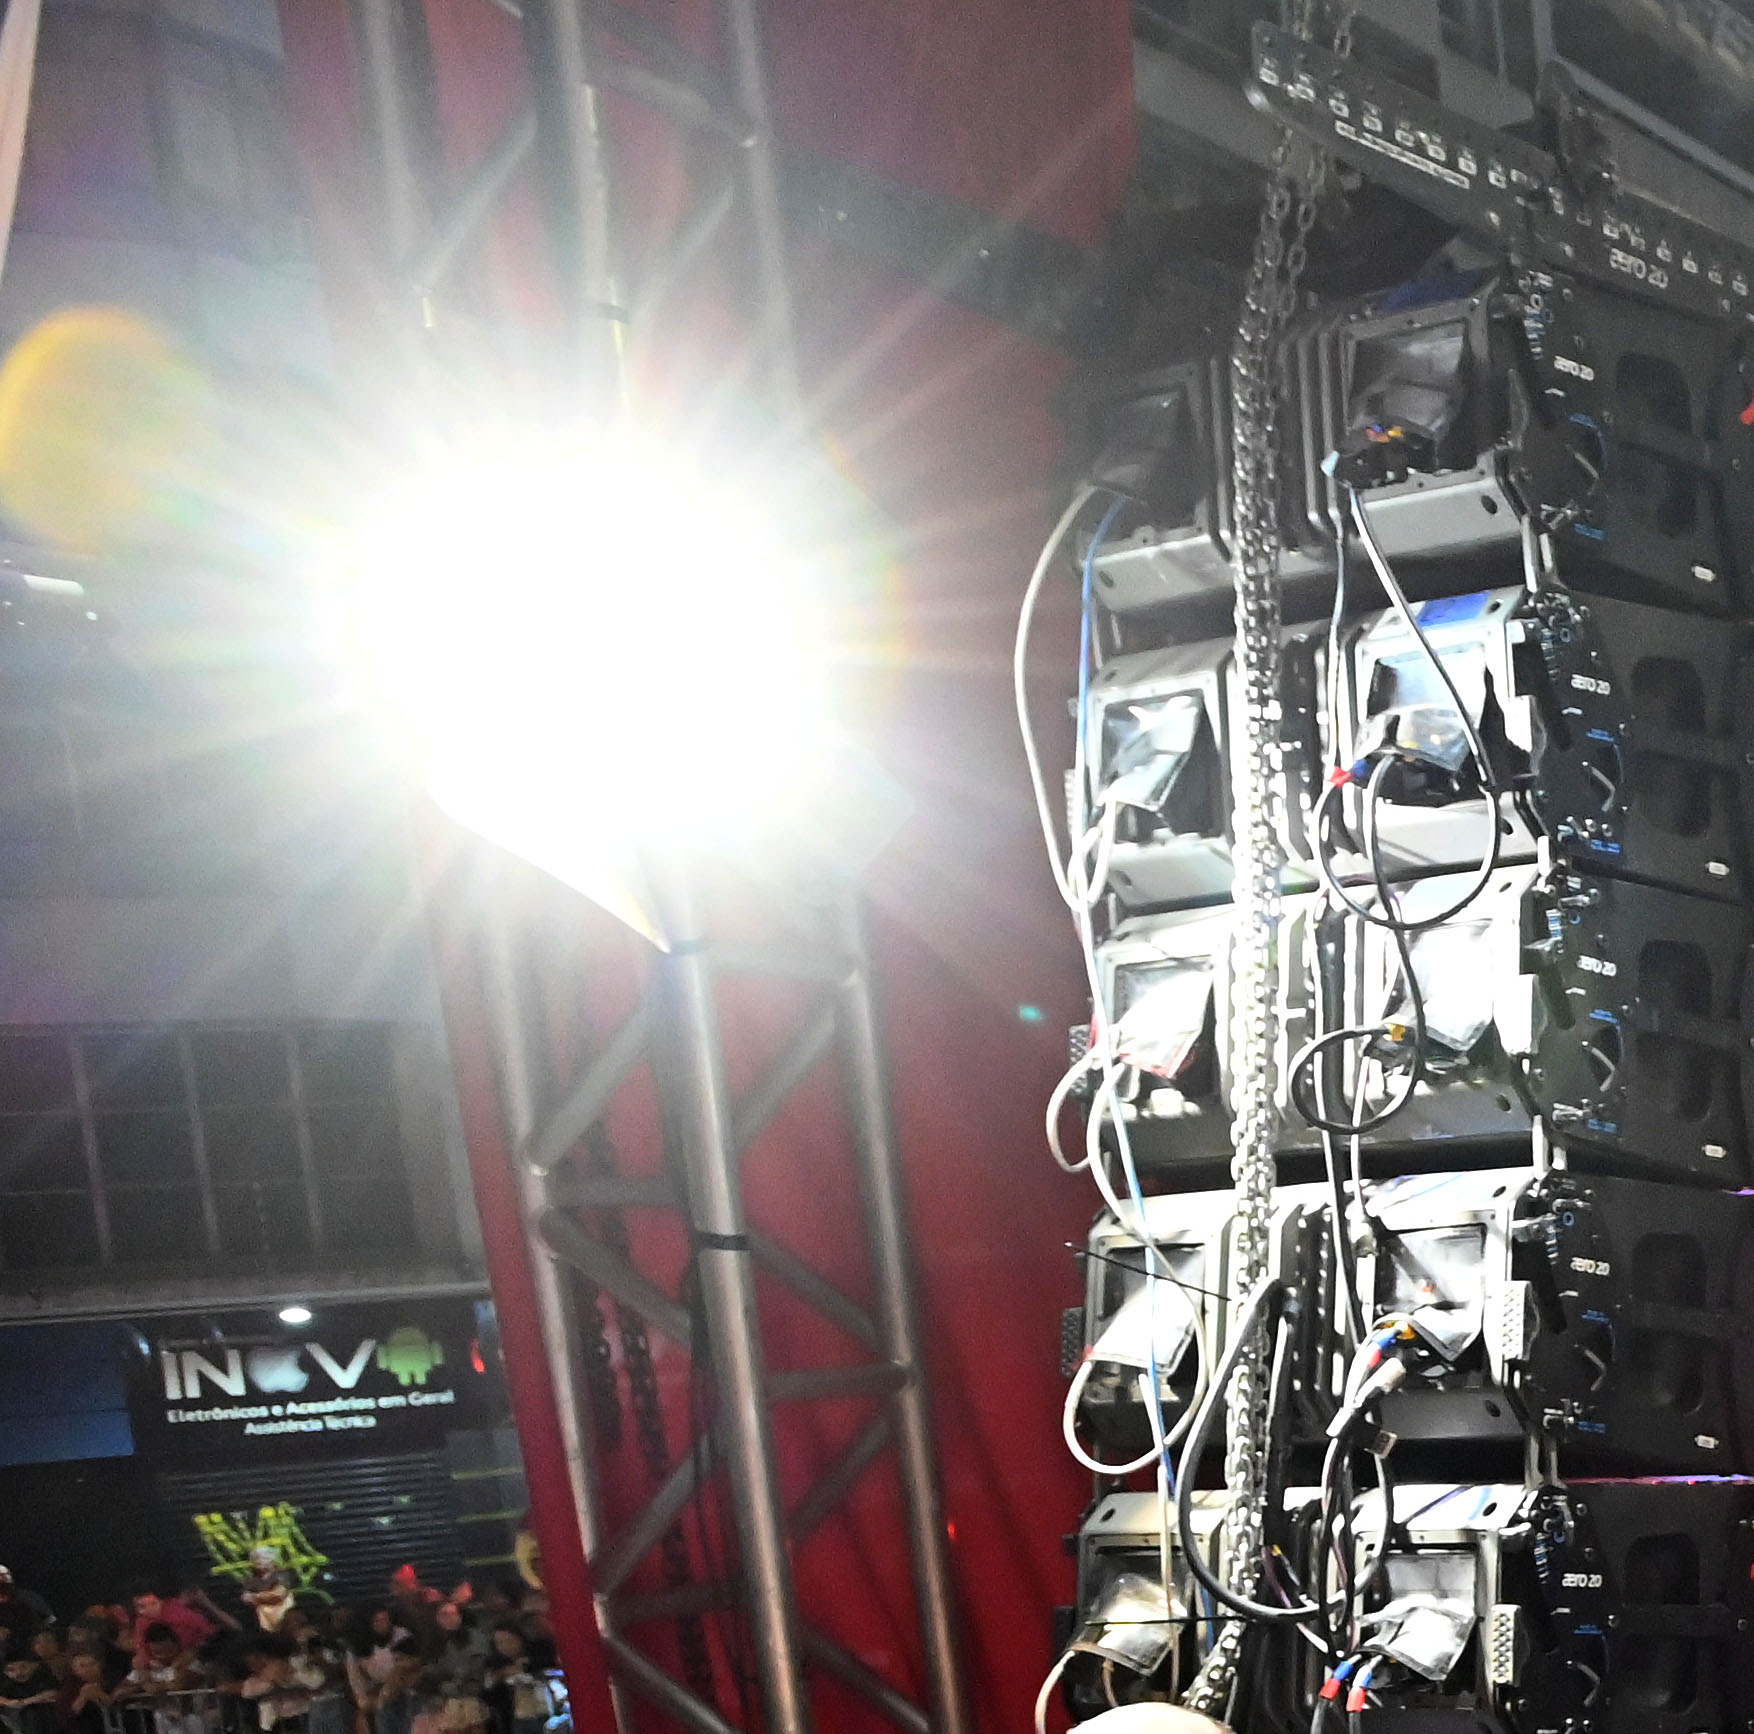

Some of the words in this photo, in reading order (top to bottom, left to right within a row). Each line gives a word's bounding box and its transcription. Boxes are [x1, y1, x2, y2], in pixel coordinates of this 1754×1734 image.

[1609, 247, 1646, 279] aero
[1648, 264, 1669, 289] 20
[1553, 355, 1580, 376] aero
[1580, 364, 1594, 381] 20
[1570, 673, 1596, 692] aero
[1596, 680, 1610, 695] 20
[1577, 955, 1602, 973] aero
[1602, 961, 1616, 977] 20
[1570, 1257, 1595, 1273] aero
[1595, 1261, 1610, 1276] 20
[167, 1404, 270, 1423] Eletrônicos
[271, 1404, 284, 1416] e
[378, 1395, 406, 1409] em
[408, 1388, 455, 1406] Geral
[1562, 1573, 1588, 1587] aero
[1587, 1574, 1602, 1588] 20
